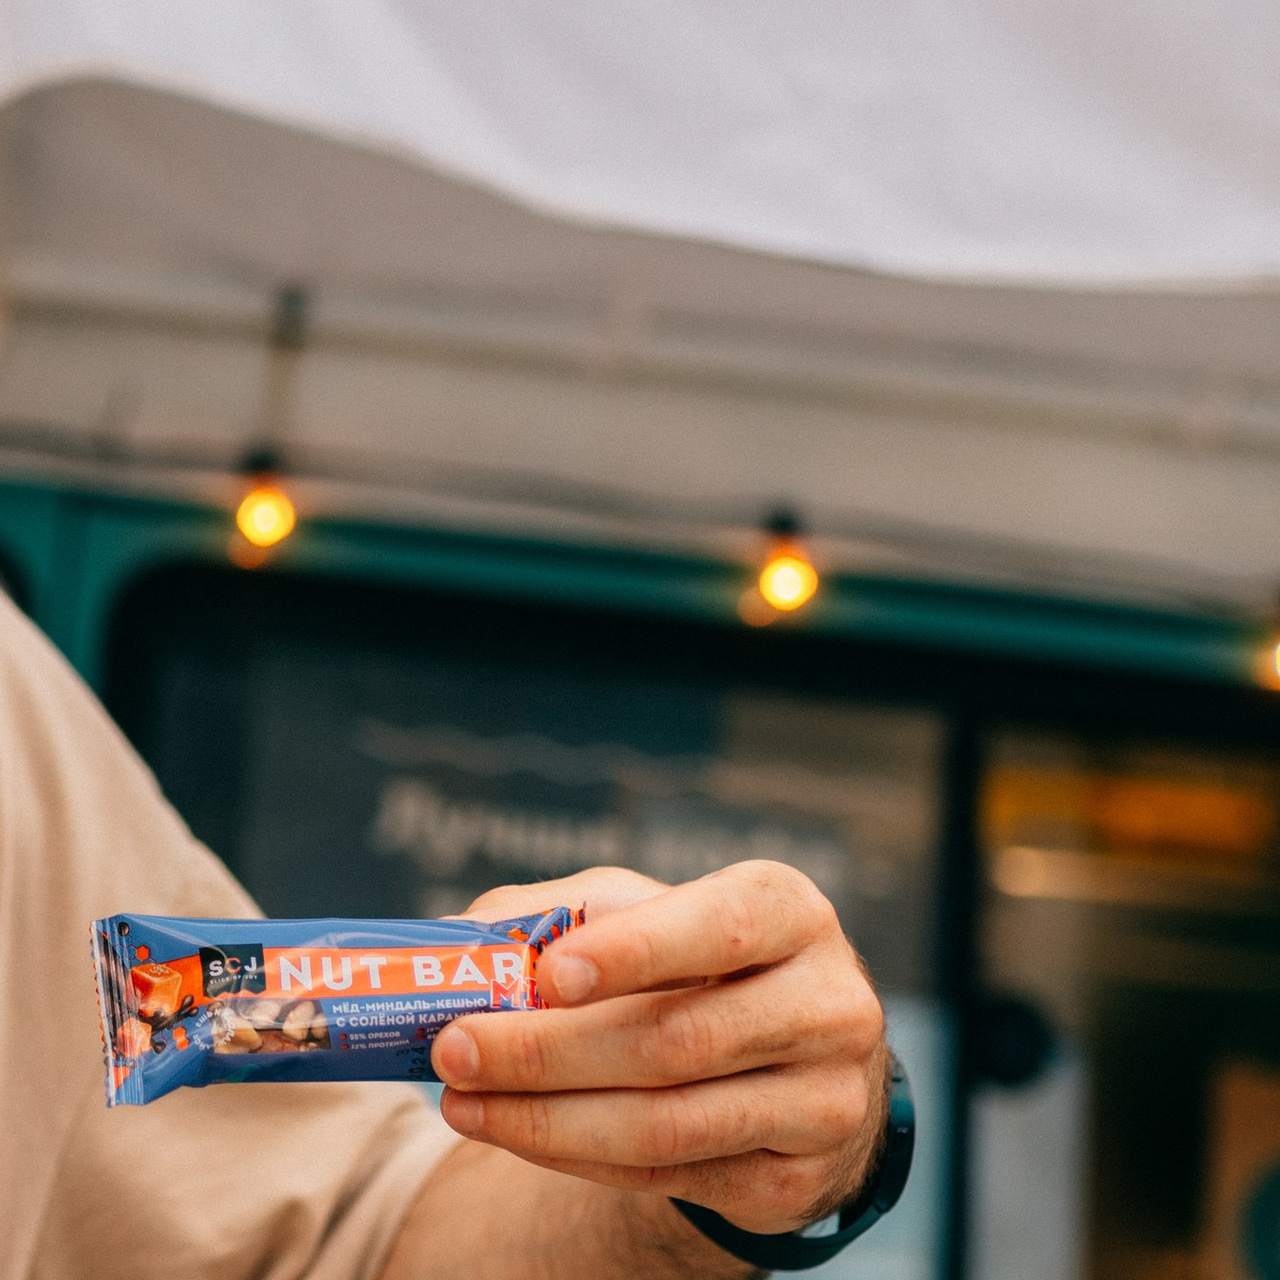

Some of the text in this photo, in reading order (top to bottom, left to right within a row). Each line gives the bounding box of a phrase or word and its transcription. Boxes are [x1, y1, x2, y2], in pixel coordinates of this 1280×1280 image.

[280, 952, 524, 991] NUT BAR
[209, 977, 229, 985] SLICE
[332, 997, 487, 1014] МЁД-МИНДАЛЬ-КЕШЬЮ
[336, 1018, 347, 1027] С
[349, 1012, 414, 1027] СОЛЁНОЙ
[368, 1031, 400, 1039] ОРЕХОВ
